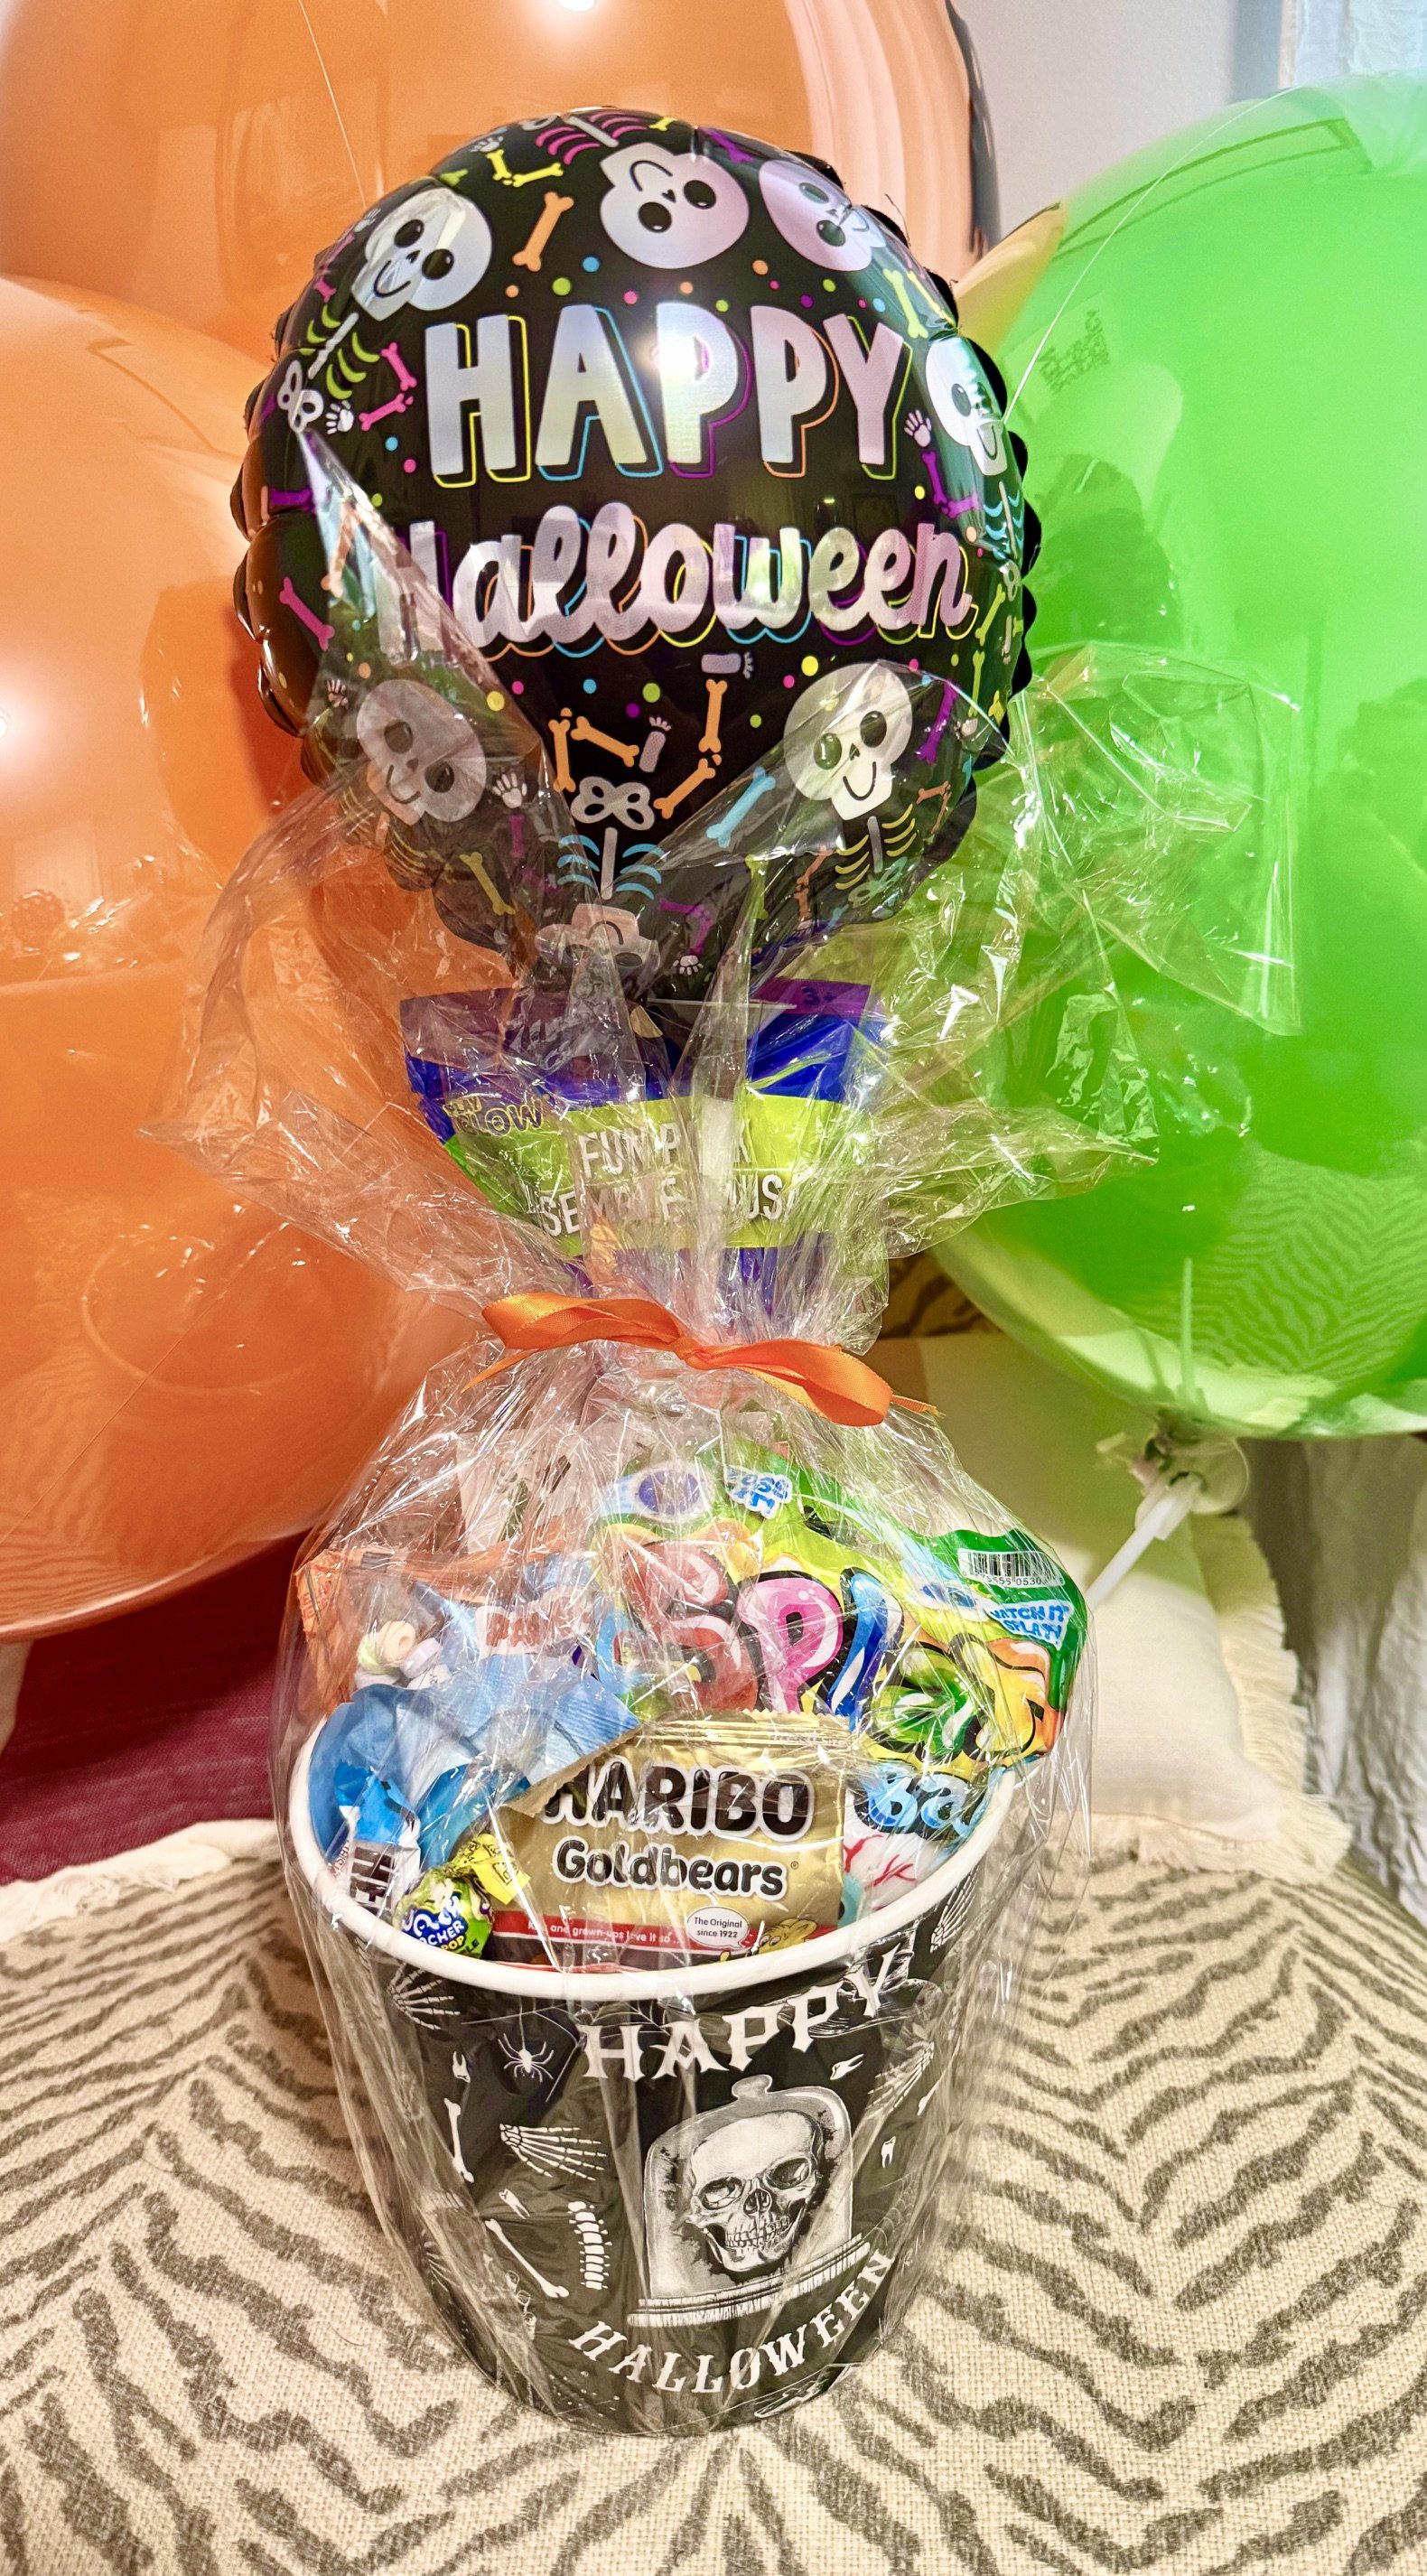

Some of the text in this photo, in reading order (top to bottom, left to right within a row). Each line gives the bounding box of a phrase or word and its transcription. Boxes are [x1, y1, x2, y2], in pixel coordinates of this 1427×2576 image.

[424, 303, 913, 488] HAPPY
[372, 502, 979, 661] Halloween
[544, 1758, 812, 1837] HARIBO
[555, 1837, 785, 1898] Goldbears
[626, 1929, 647, 1942] lve
[694, 1917, 742, 1929] The Original
[696, 1929, 738, 1938] since 1922
[575, 1943, 904, 2083] HAPPY
[569, 2251, 897, 2394] HALLOWEEN
